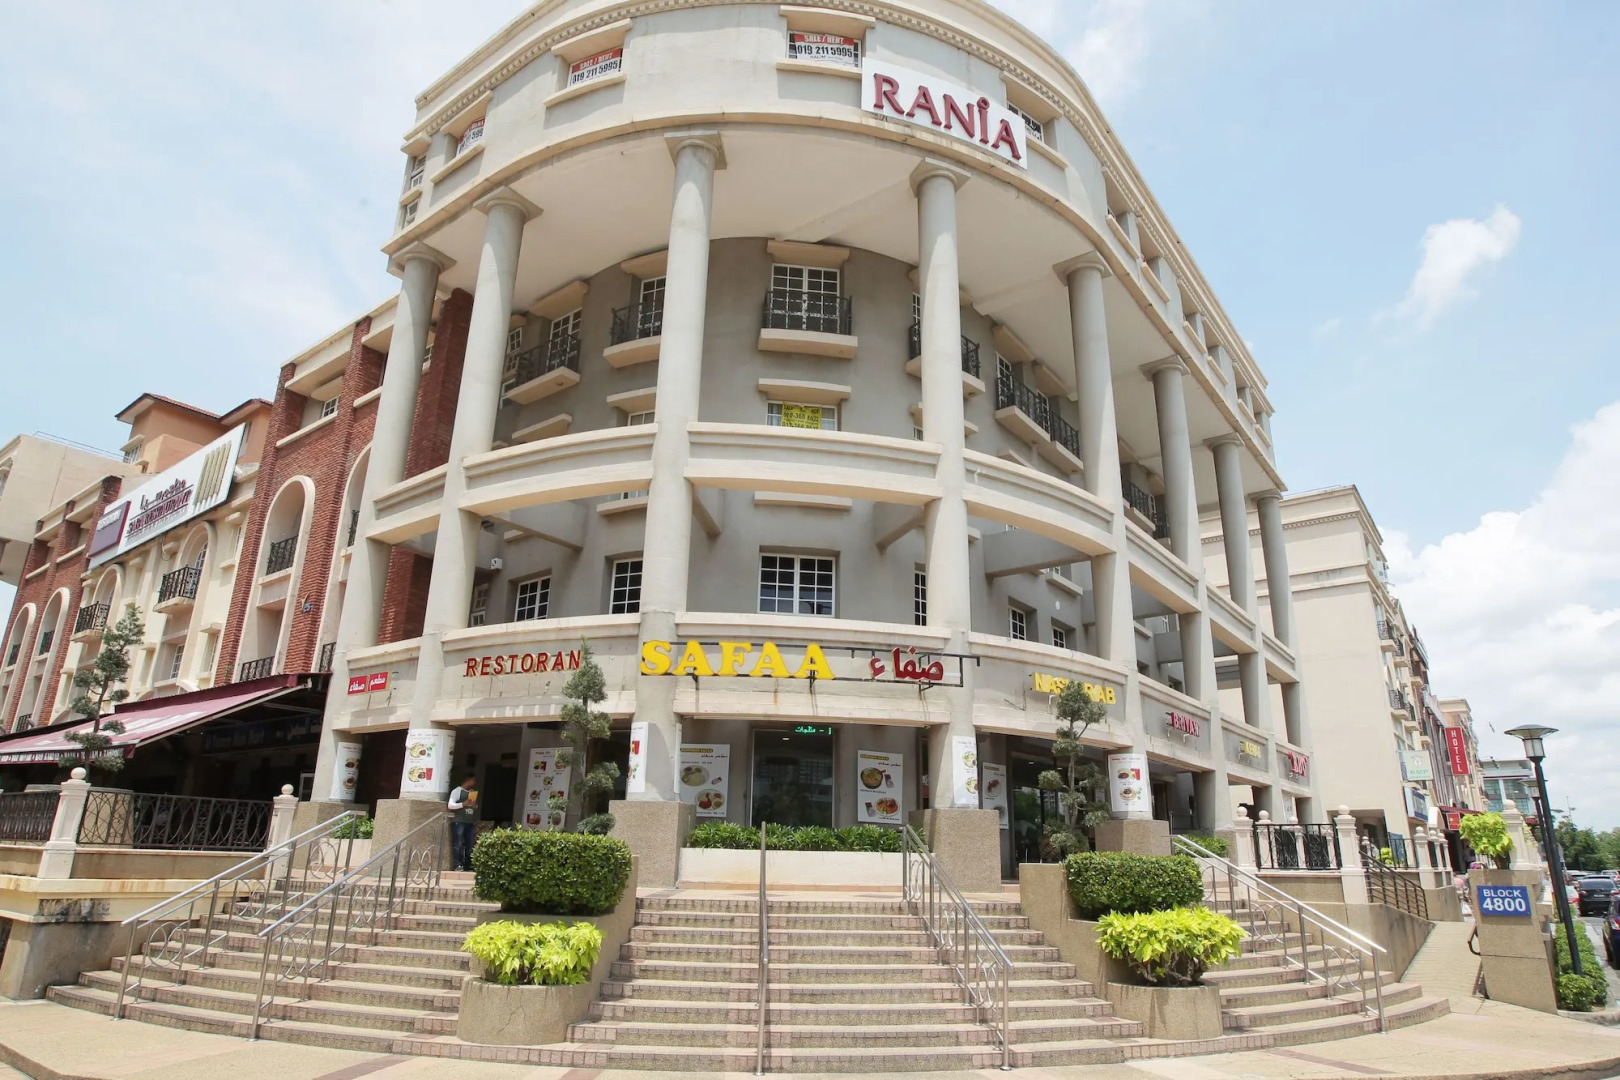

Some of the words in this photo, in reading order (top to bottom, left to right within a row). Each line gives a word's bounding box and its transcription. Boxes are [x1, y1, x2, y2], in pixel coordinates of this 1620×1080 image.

[797, 45, 812, 54] 019
[815, 46, 829, 54] 211
[830, 47, 853, 57] 5995
[586, 67, 598, 79] 211
[598, 60, 618, 74] 5995
[466, 649, 582, 677] RESTORAN
[639, 639, 836, 680] SAFAA
[868, 645, 944, 681] صفاء
[349, 680, 365, 692] صفاء
[369, 674, 386, 692] مطعم
[1034, 672, 1069, 695] NAS
[1083, 682, 1117, 705] RAB
[1450, 729, 1463, 772] HOTEL
[1482, 889, 1522, 897] BLOCK
[1482, 897, 1526, 912] 4800
